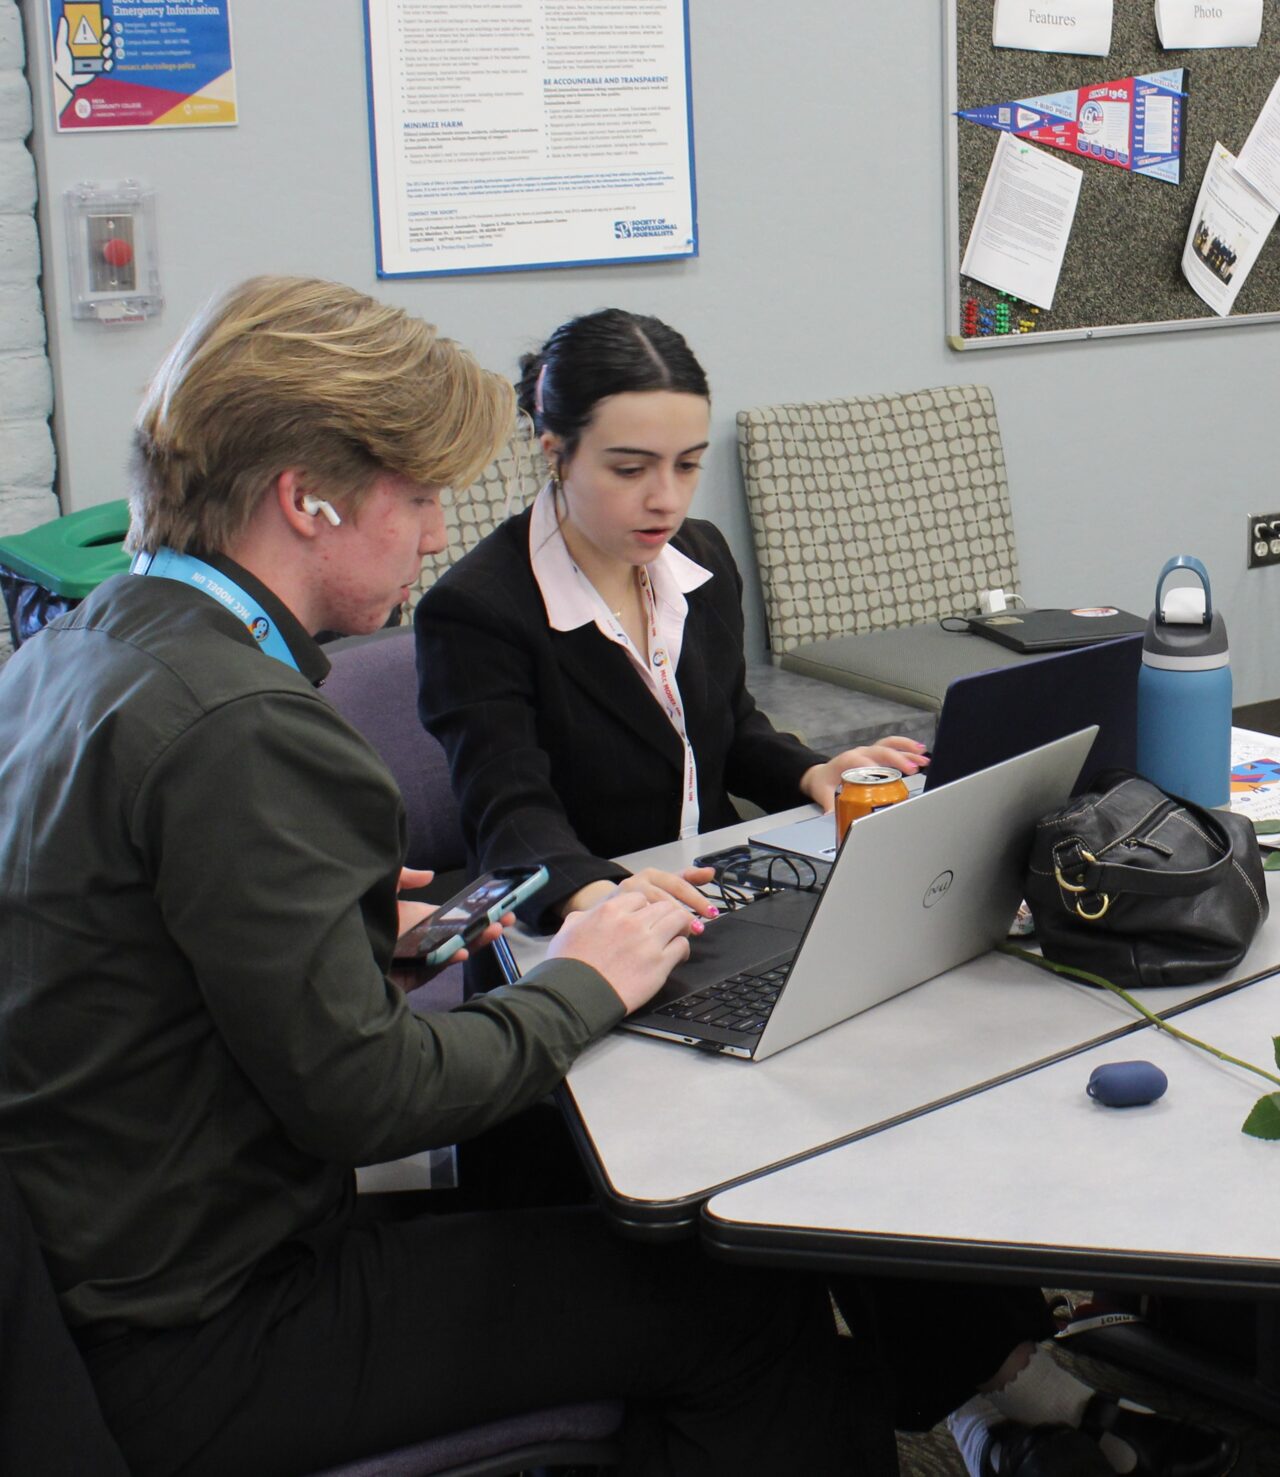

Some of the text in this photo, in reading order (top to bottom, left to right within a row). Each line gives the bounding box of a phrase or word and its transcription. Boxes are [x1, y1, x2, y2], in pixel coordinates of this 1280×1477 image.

[113, 5, 219, 17] Emergency Information
[1194, 5, 1223, 19] Photo
[1029, 9, 1076, 26] Features
[553, 77, 603, 85] ACCOUNTABLE
[604, 76, 620, 84] AND
[1088, 87, 1108, 99] SINCE
[1109, 89, 1128, 99] 1965
[632, 224, 678, 232] PROFESSIONAL
[632, 230, 674, 238] JOURNALISTS
[191, 571, 252, 620] MCC MODEL UN
[663, 684, 677, 705] MODEL
